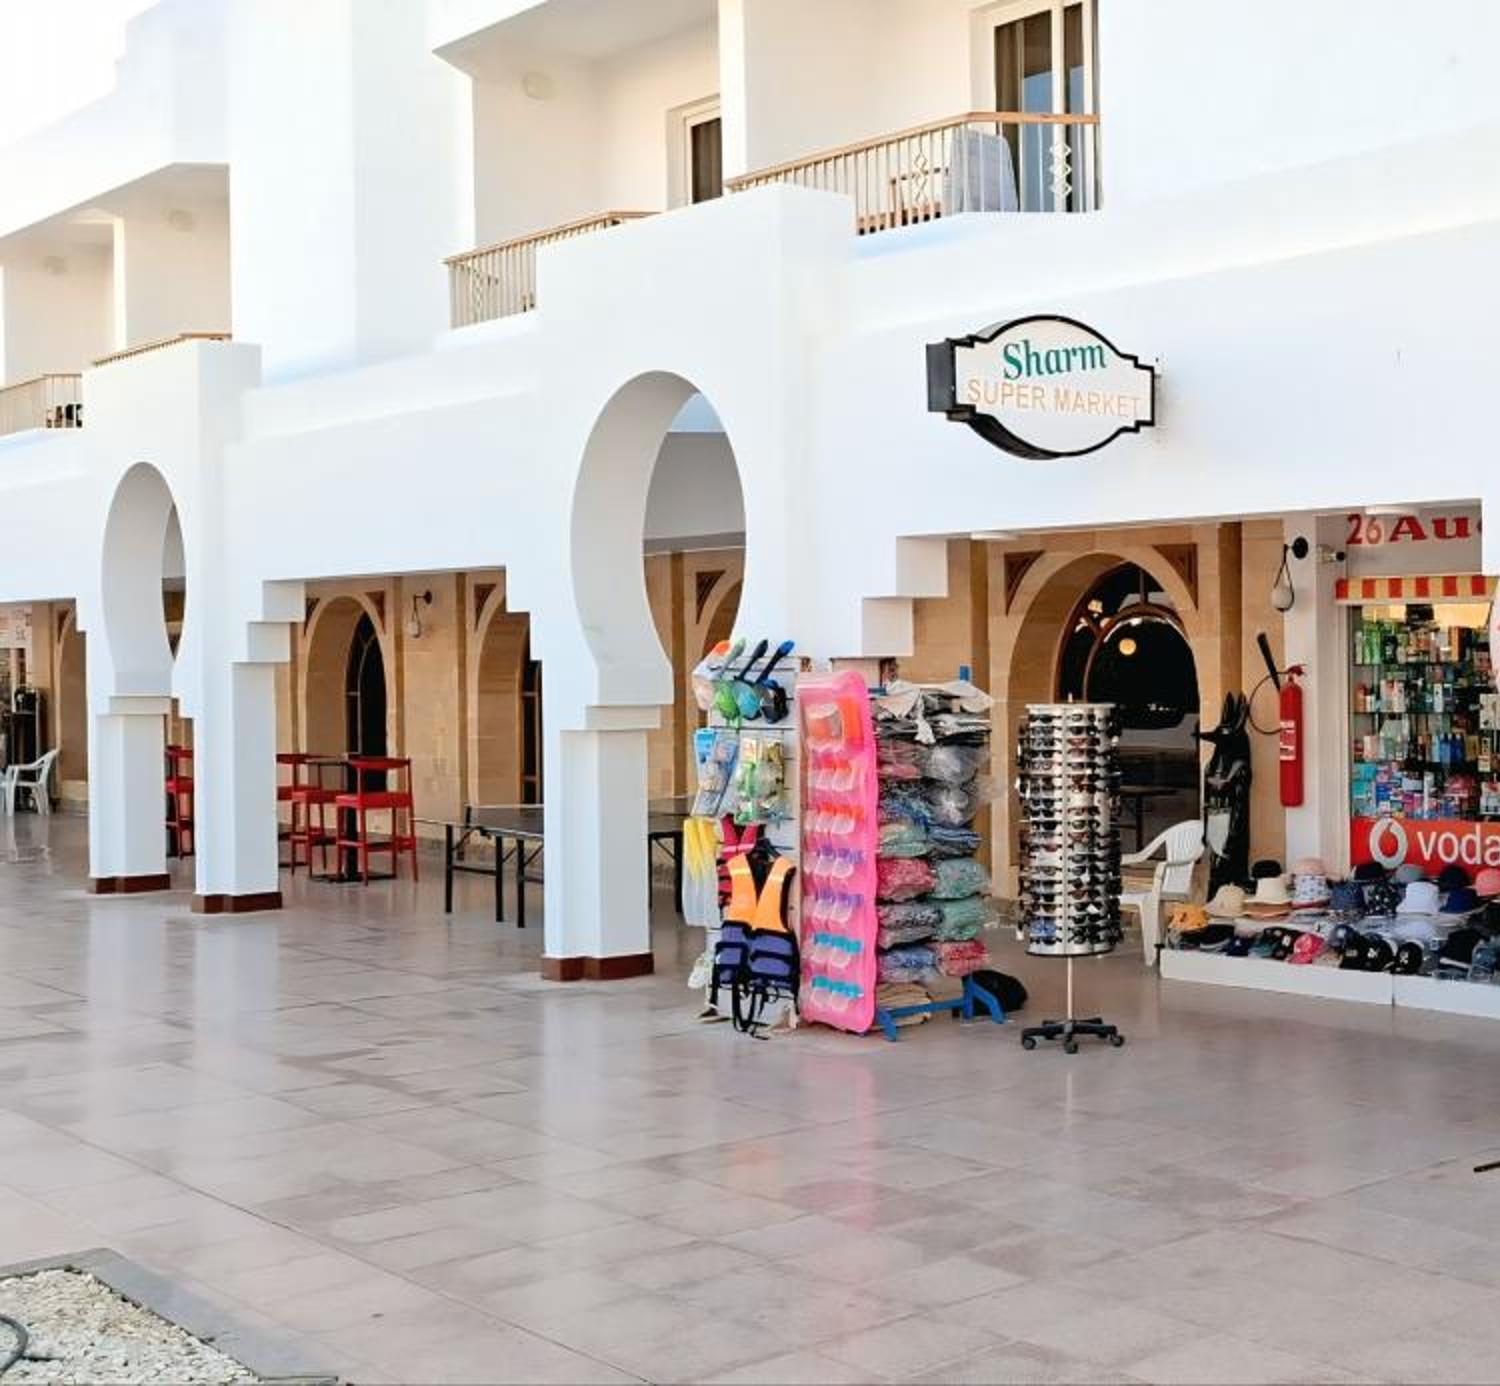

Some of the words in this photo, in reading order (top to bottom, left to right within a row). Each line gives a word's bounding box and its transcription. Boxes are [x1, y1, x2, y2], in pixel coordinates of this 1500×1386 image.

[1003, 339, 1107, 380] Sharm
[967, 379, 1046, 411] SUPER
[1055, 387, 1141, 418] MARKET
[1345, 514, 1383, 545] 26
[1388, 515, 1482, 543] Au
